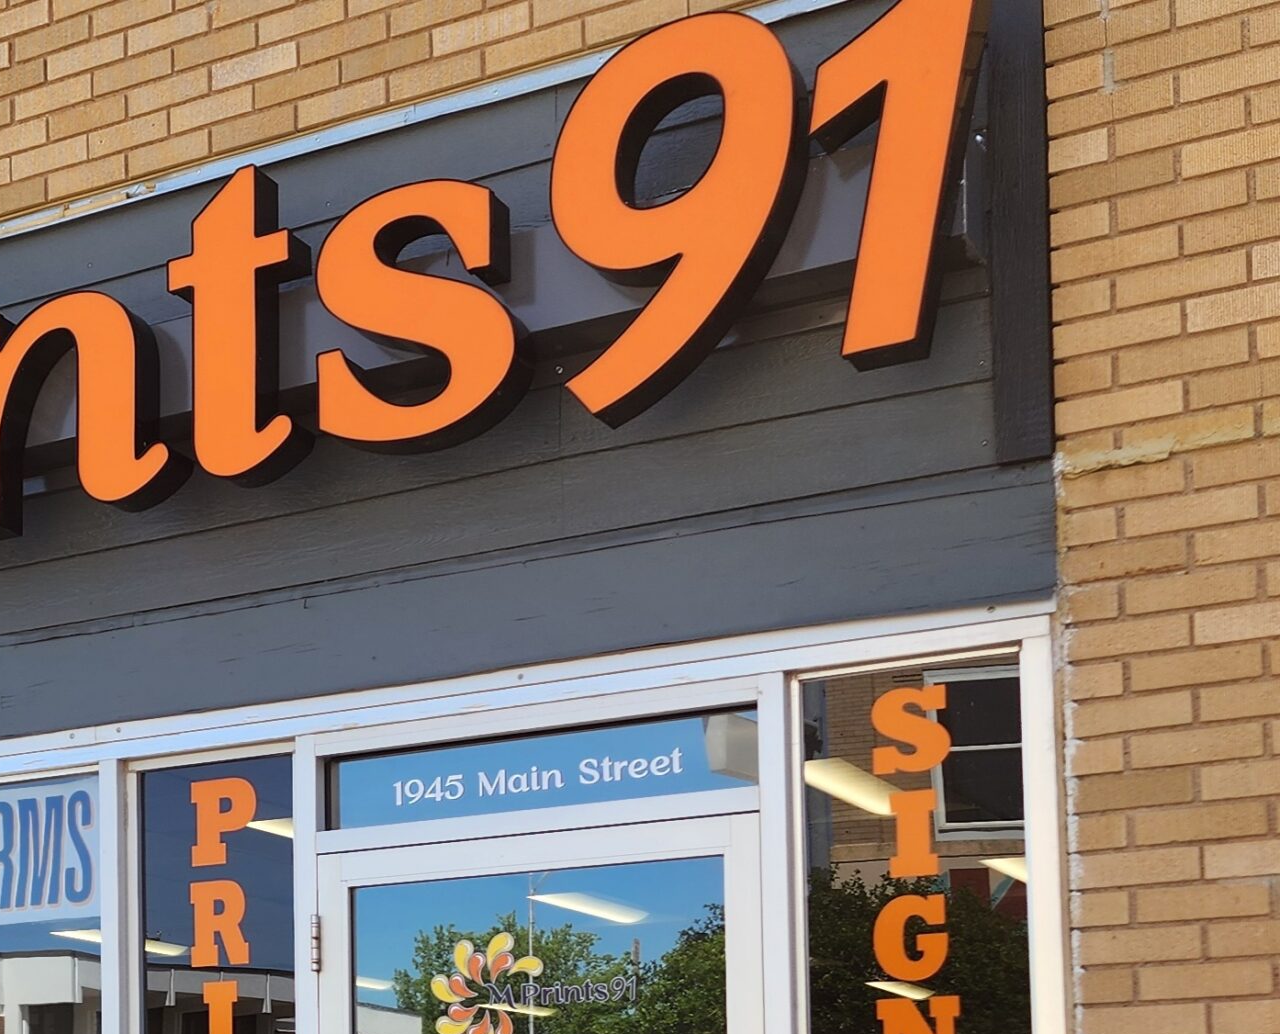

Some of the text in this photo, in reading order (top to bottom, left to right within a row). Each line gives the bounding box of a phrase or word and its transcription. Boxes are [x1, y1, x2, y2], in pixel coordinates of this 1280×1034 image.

[393, 747, 684, 807] 1945 Main Street
[484, 976, 638, 1009] M Prints91
